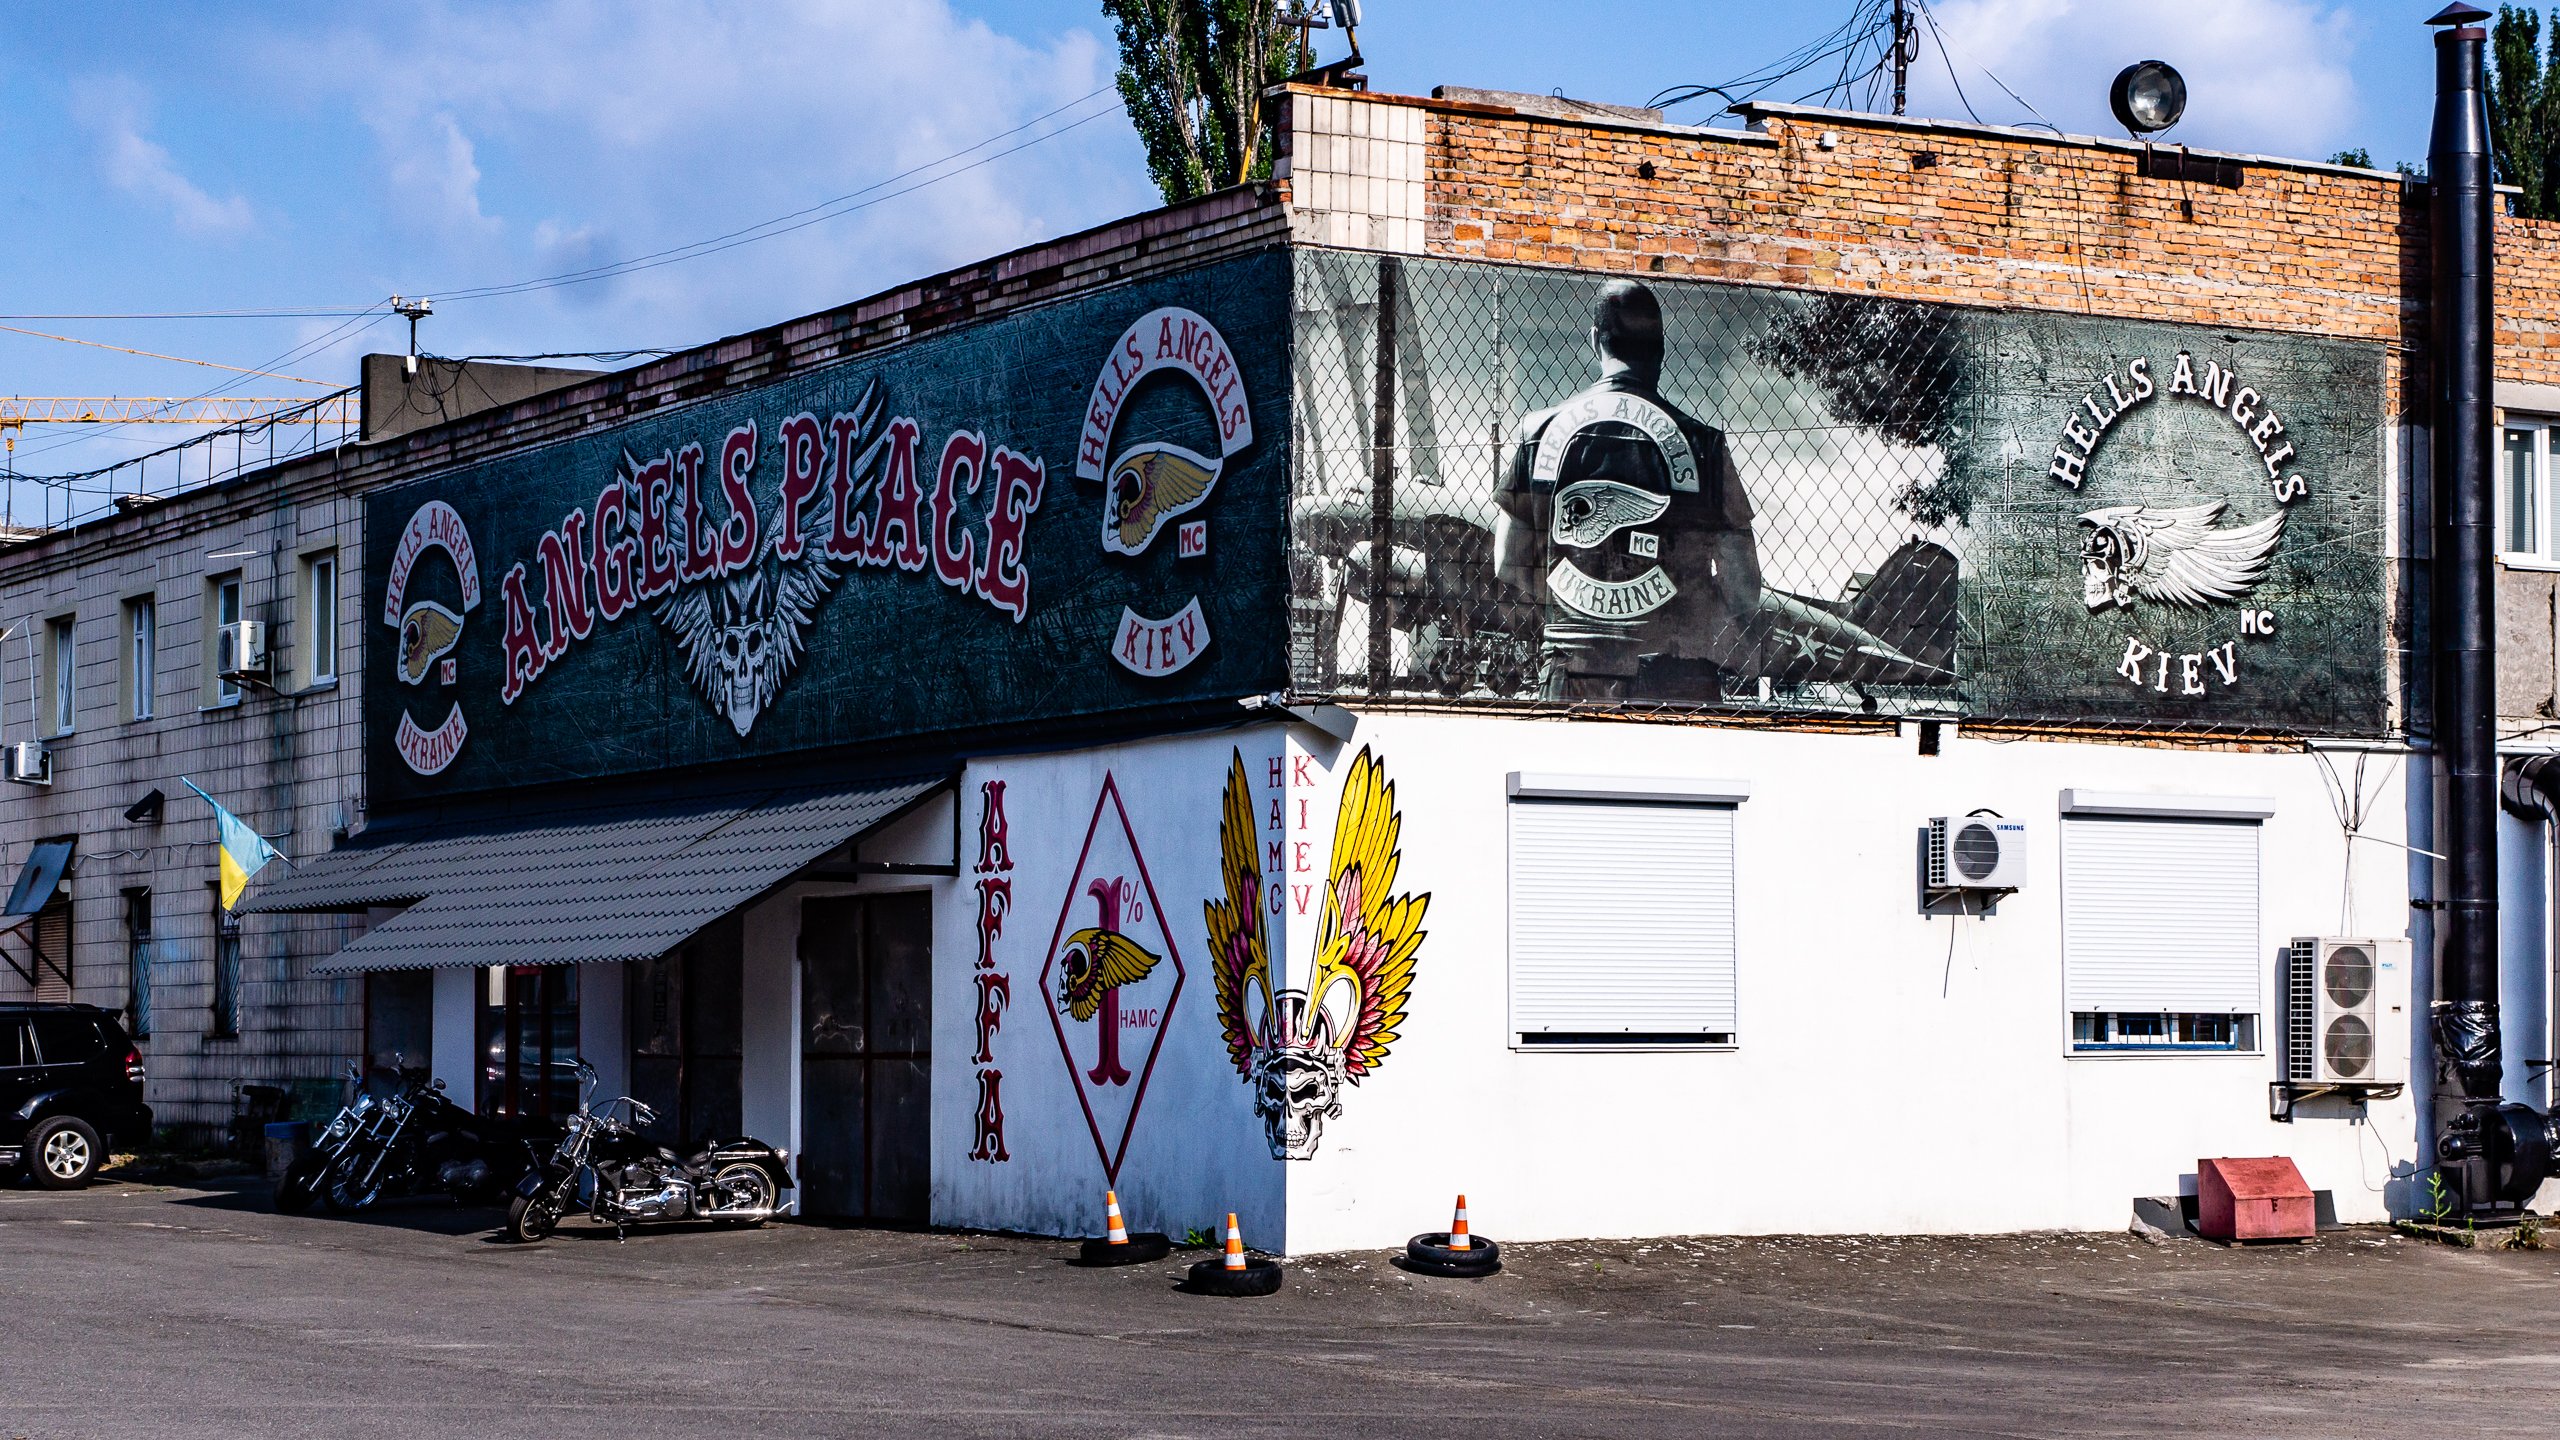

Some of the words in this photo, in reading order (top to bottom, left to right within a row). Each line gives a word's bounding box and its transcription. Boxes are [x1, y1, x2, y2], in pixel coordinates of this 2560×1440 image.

[1081, 330, 1144, 473] HELLS
[1155, 315, 1246, 440] ANGELS
[1539, 400, 1599, 474] HELLS
[1612, 398, 1695, 484] ANGELS
[2049, 356, 2155, 489] HELLS
[2168, 354, 2307, 502] ANGELS
[387, 517, 422, 619] HELLS
[428, 507, 479, 601] ANGELS
[501, 418, 757, 706] ANGELS
[775, 412, 1046, 624] PLACE
[1181, 526, 1204, 555] MC
[1633, 535, 1656, 554] MC
[1557, 566, 1671, 615] UKRAINE
[1123, 610, 1195, 671] KIEV
[2240, 609, 2275, 634] MC
[442, 663, 456, 681] MC
[2116, 636, 2239, 695] KIEV
[402, 711, 464, 769] UKRAINE
[1996, 824, 2025, 832] SAMSUNG
[1119, 1009, 1158, 1030] HAMC
